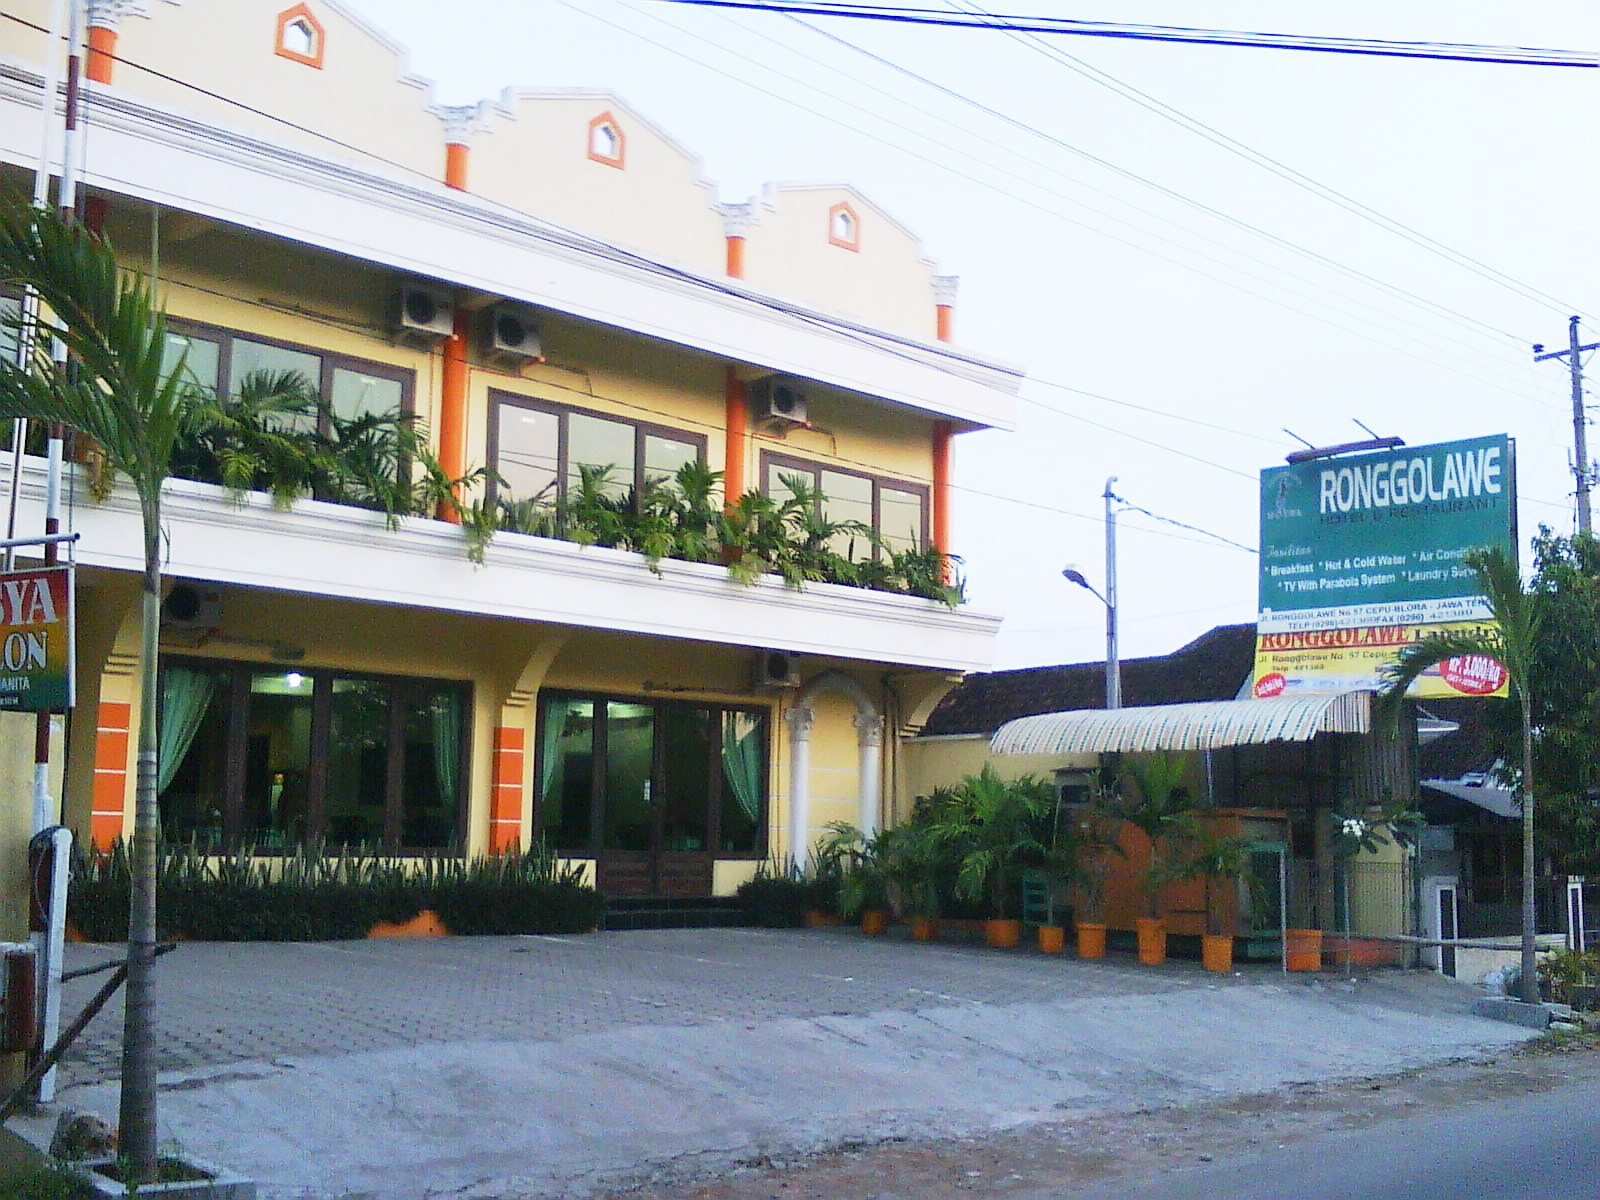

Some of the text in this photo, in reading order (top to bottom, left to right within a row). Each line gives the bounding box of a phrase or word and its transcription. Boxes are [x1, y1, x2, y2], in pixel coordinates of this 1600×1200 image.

[1320, 447, 1501, 514] RONGGOLAWE
[1271, 563, 1314, 577] Breakfast
[1325, 560, 1341, 571] Hot
[1344, 558, 1351, 569] &
[1353, 556, 1376, 568] Cold
[1378, 554, 1406, 566] Water
[1419, 550, 1433, 562] Air
[1284, 581, 1295, 592] TV
[1297, 579, 1318, 591] With
[1320, 576, 1359, 589] Parabola
[1361, 572, 1396, 587] System
[1408, 569, 1449, 582] Laundry
[0, 578, 59, 625] YA
[1437, 600, 1463, 610] JAWA
[1260, 625, 1407, 649] RONGGOLAWE
[0, 632, 48, 671] ON
